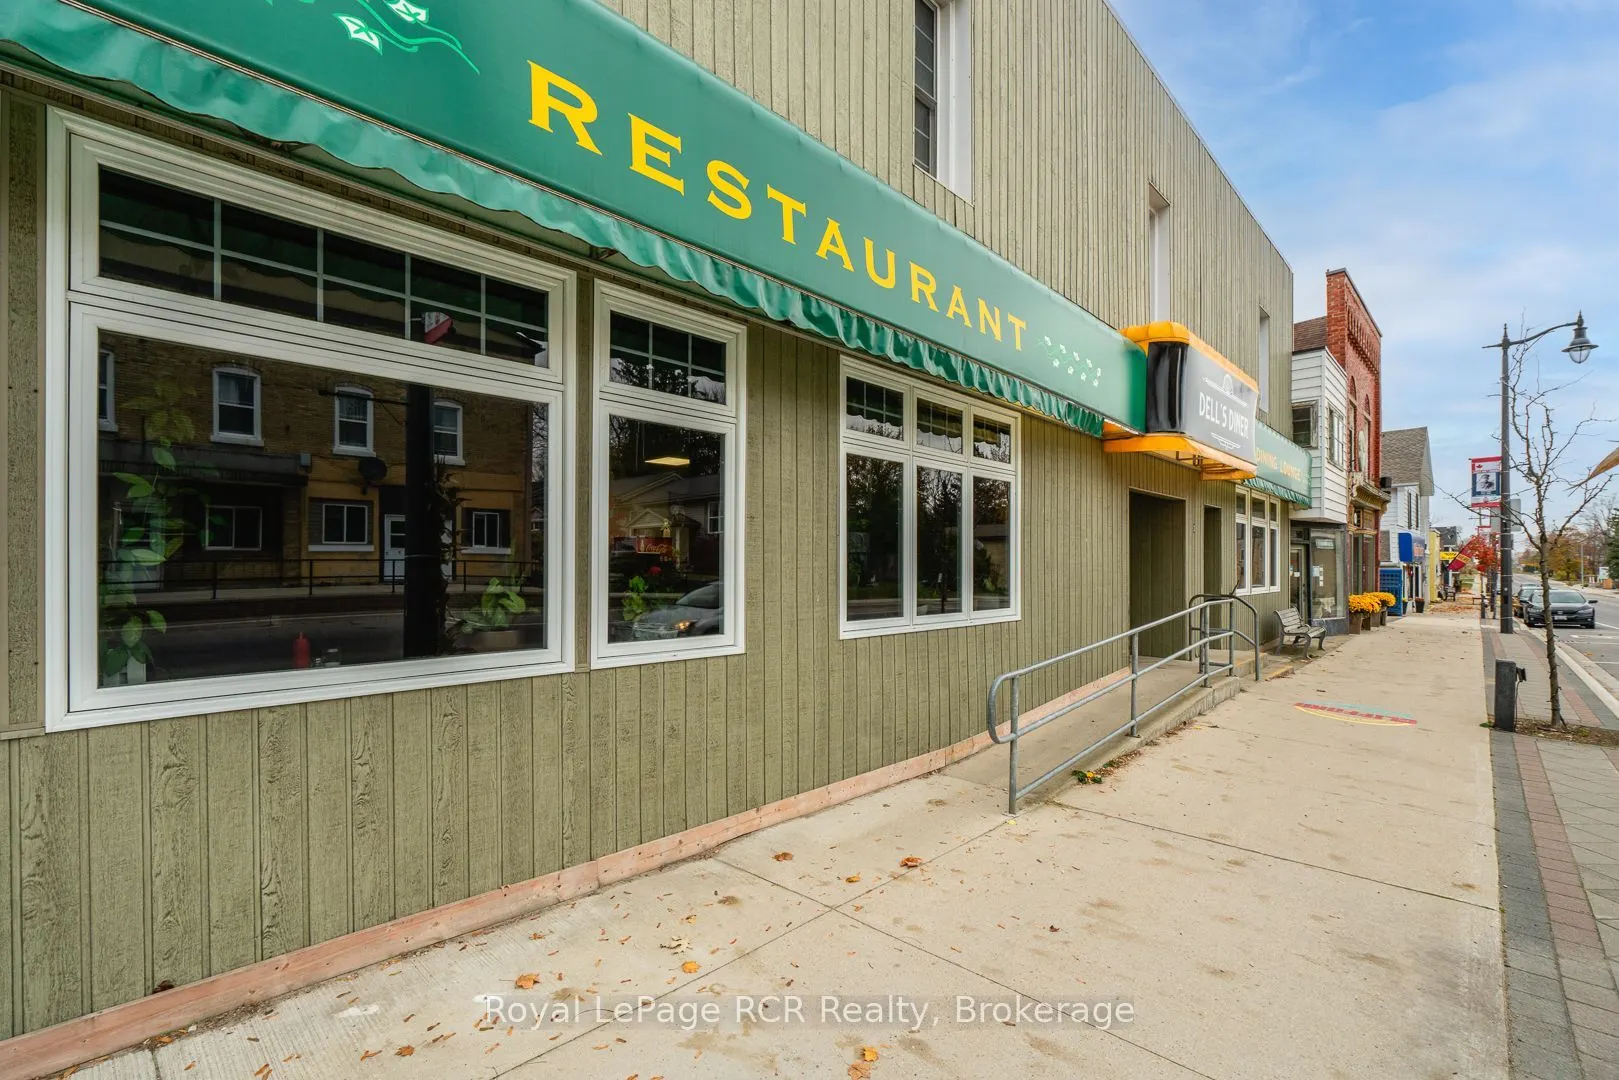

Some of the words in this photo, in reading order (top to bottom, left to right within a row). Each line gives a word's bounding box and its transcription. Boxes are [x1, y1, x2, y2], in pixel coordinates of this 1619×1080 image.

[527, 60, 1028, 351] RESTAURANT
[1199, 391, 1227, 428] DELL'S
[1228, 408, 1249, 440] DINER
